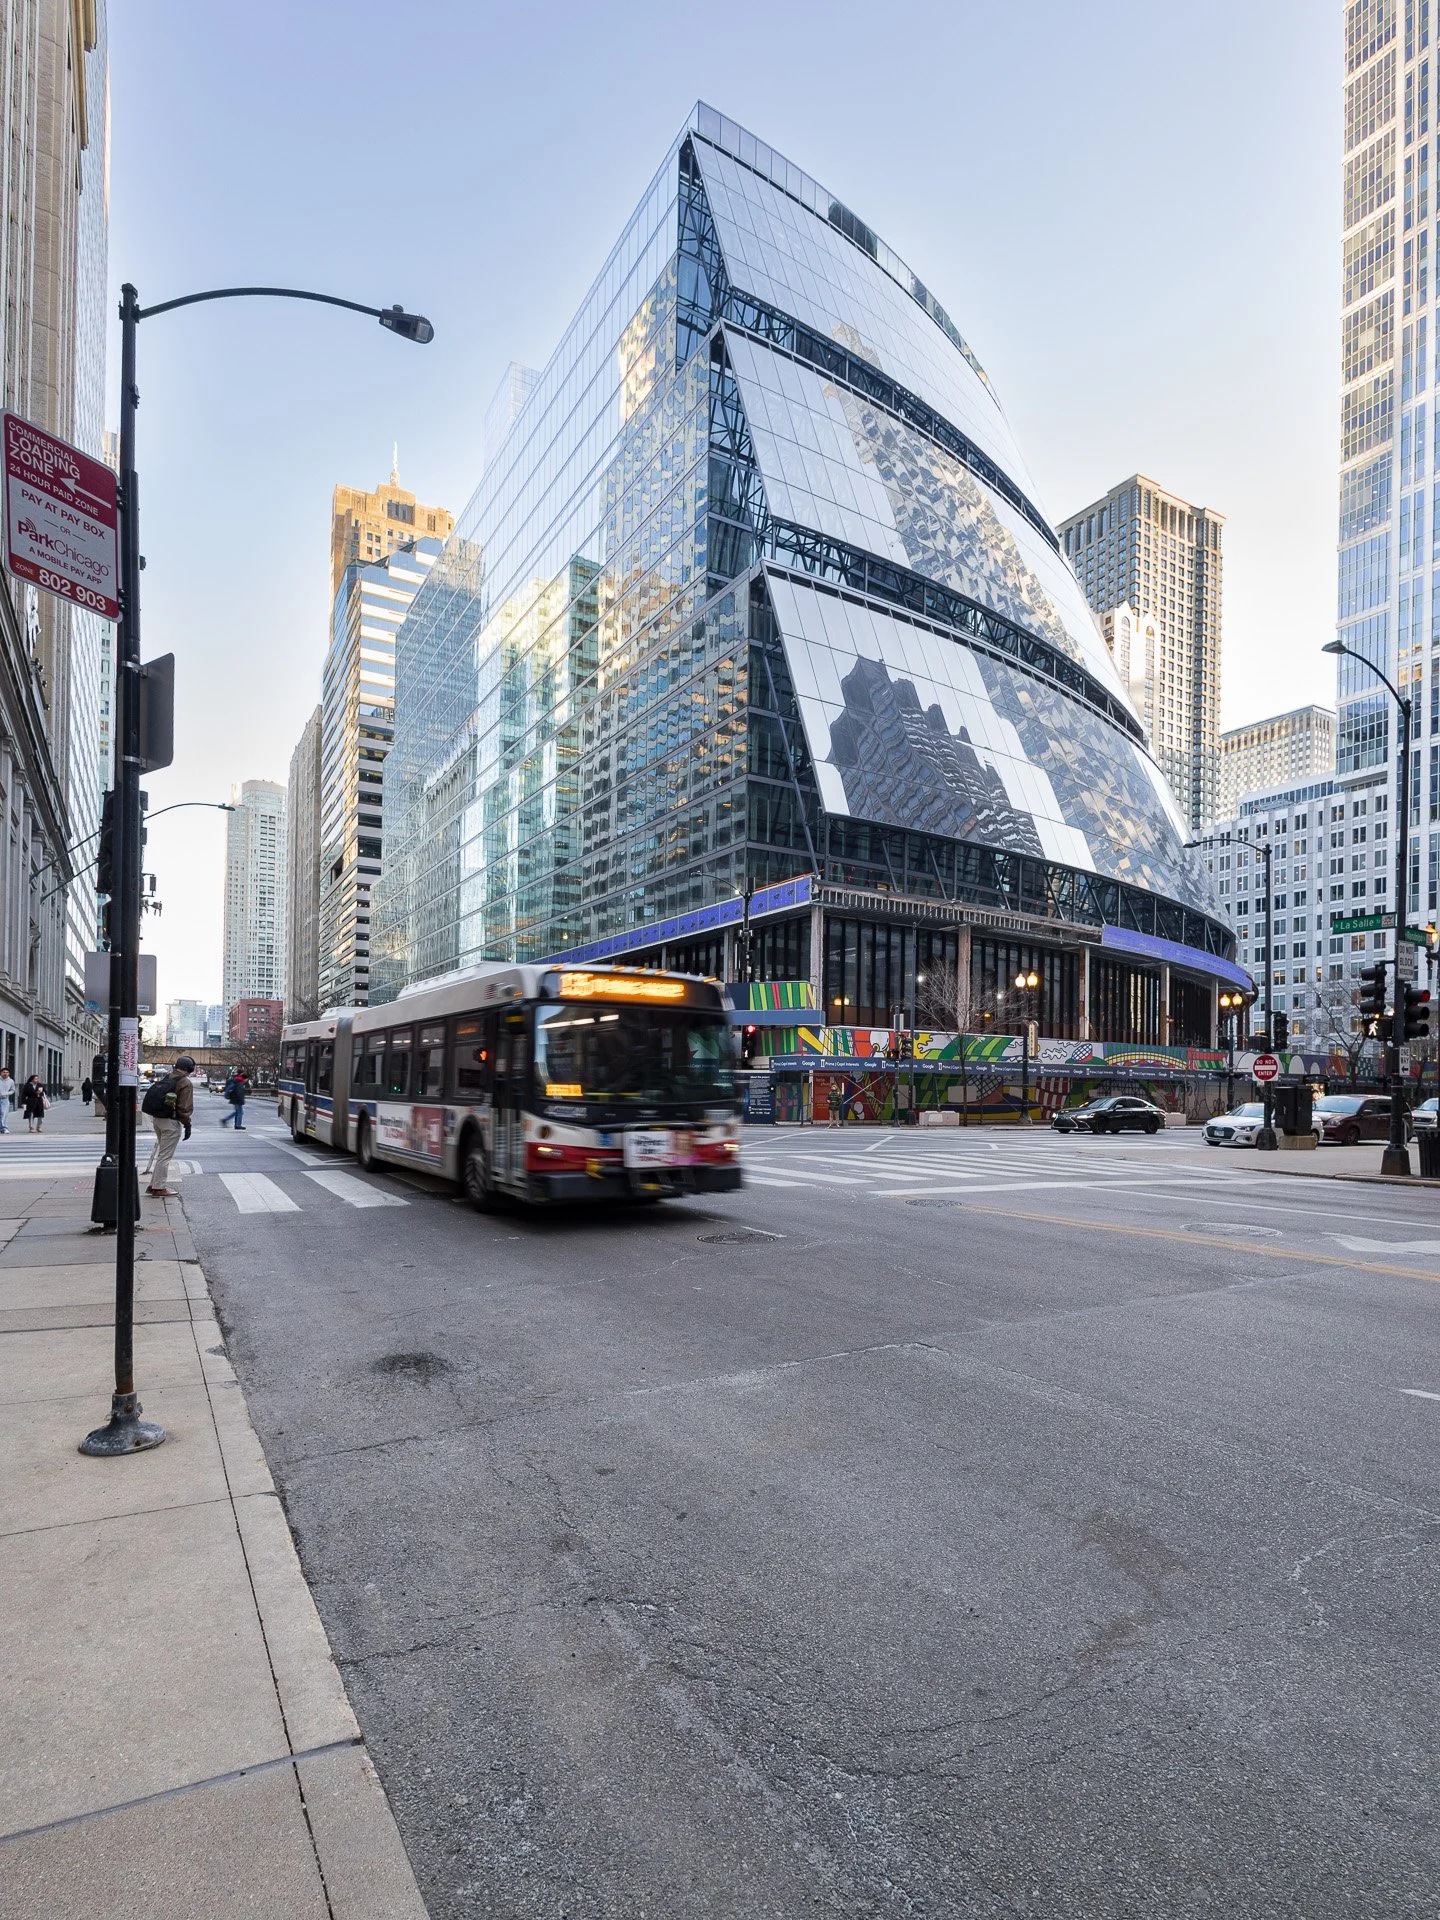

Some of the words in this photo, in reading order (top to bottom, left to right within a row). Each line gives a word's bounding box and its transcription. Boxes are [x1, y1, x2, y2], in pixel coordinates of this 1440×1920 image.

[9, 421, 76, 465] COMMERCIAL
[9, 430, 81, 480] LOADING
[9, 443, 54, 479] ZONE
[10, 463, 21, 475] 24
[23, 469, 51, 490] HOUR
[53, 485, 73, 502] PAID
[75, 498, 99, 516] ZONE
[21, 488, 42, 506] PAY
[45, 502, 58, 514] AT
[61, 509, 80, 526] PAY
[83, 521, 106, 540] BOX
[60, 525, 71, 536] OR
[29, 546, 35, 554] A
[37, 549, 69, 569] MOBILE
[70, 565, 85, 578] PAY
[87, 574, 102, 584] APP
[15, 562, 34, 575] ZONE
[39, 568, 72, 597] 802
[75, 585, 106, 611] 903
[1340, 921, 1350, 930] La
[1352, 919, 1374, 928] Salle
[1399, 945, 1405, 954] DO
[1399, 957, 1412, 966] BLOCK
[130, 1034, 136, 1043] NO
[1401, 1048, 1409, 1056] ONE
